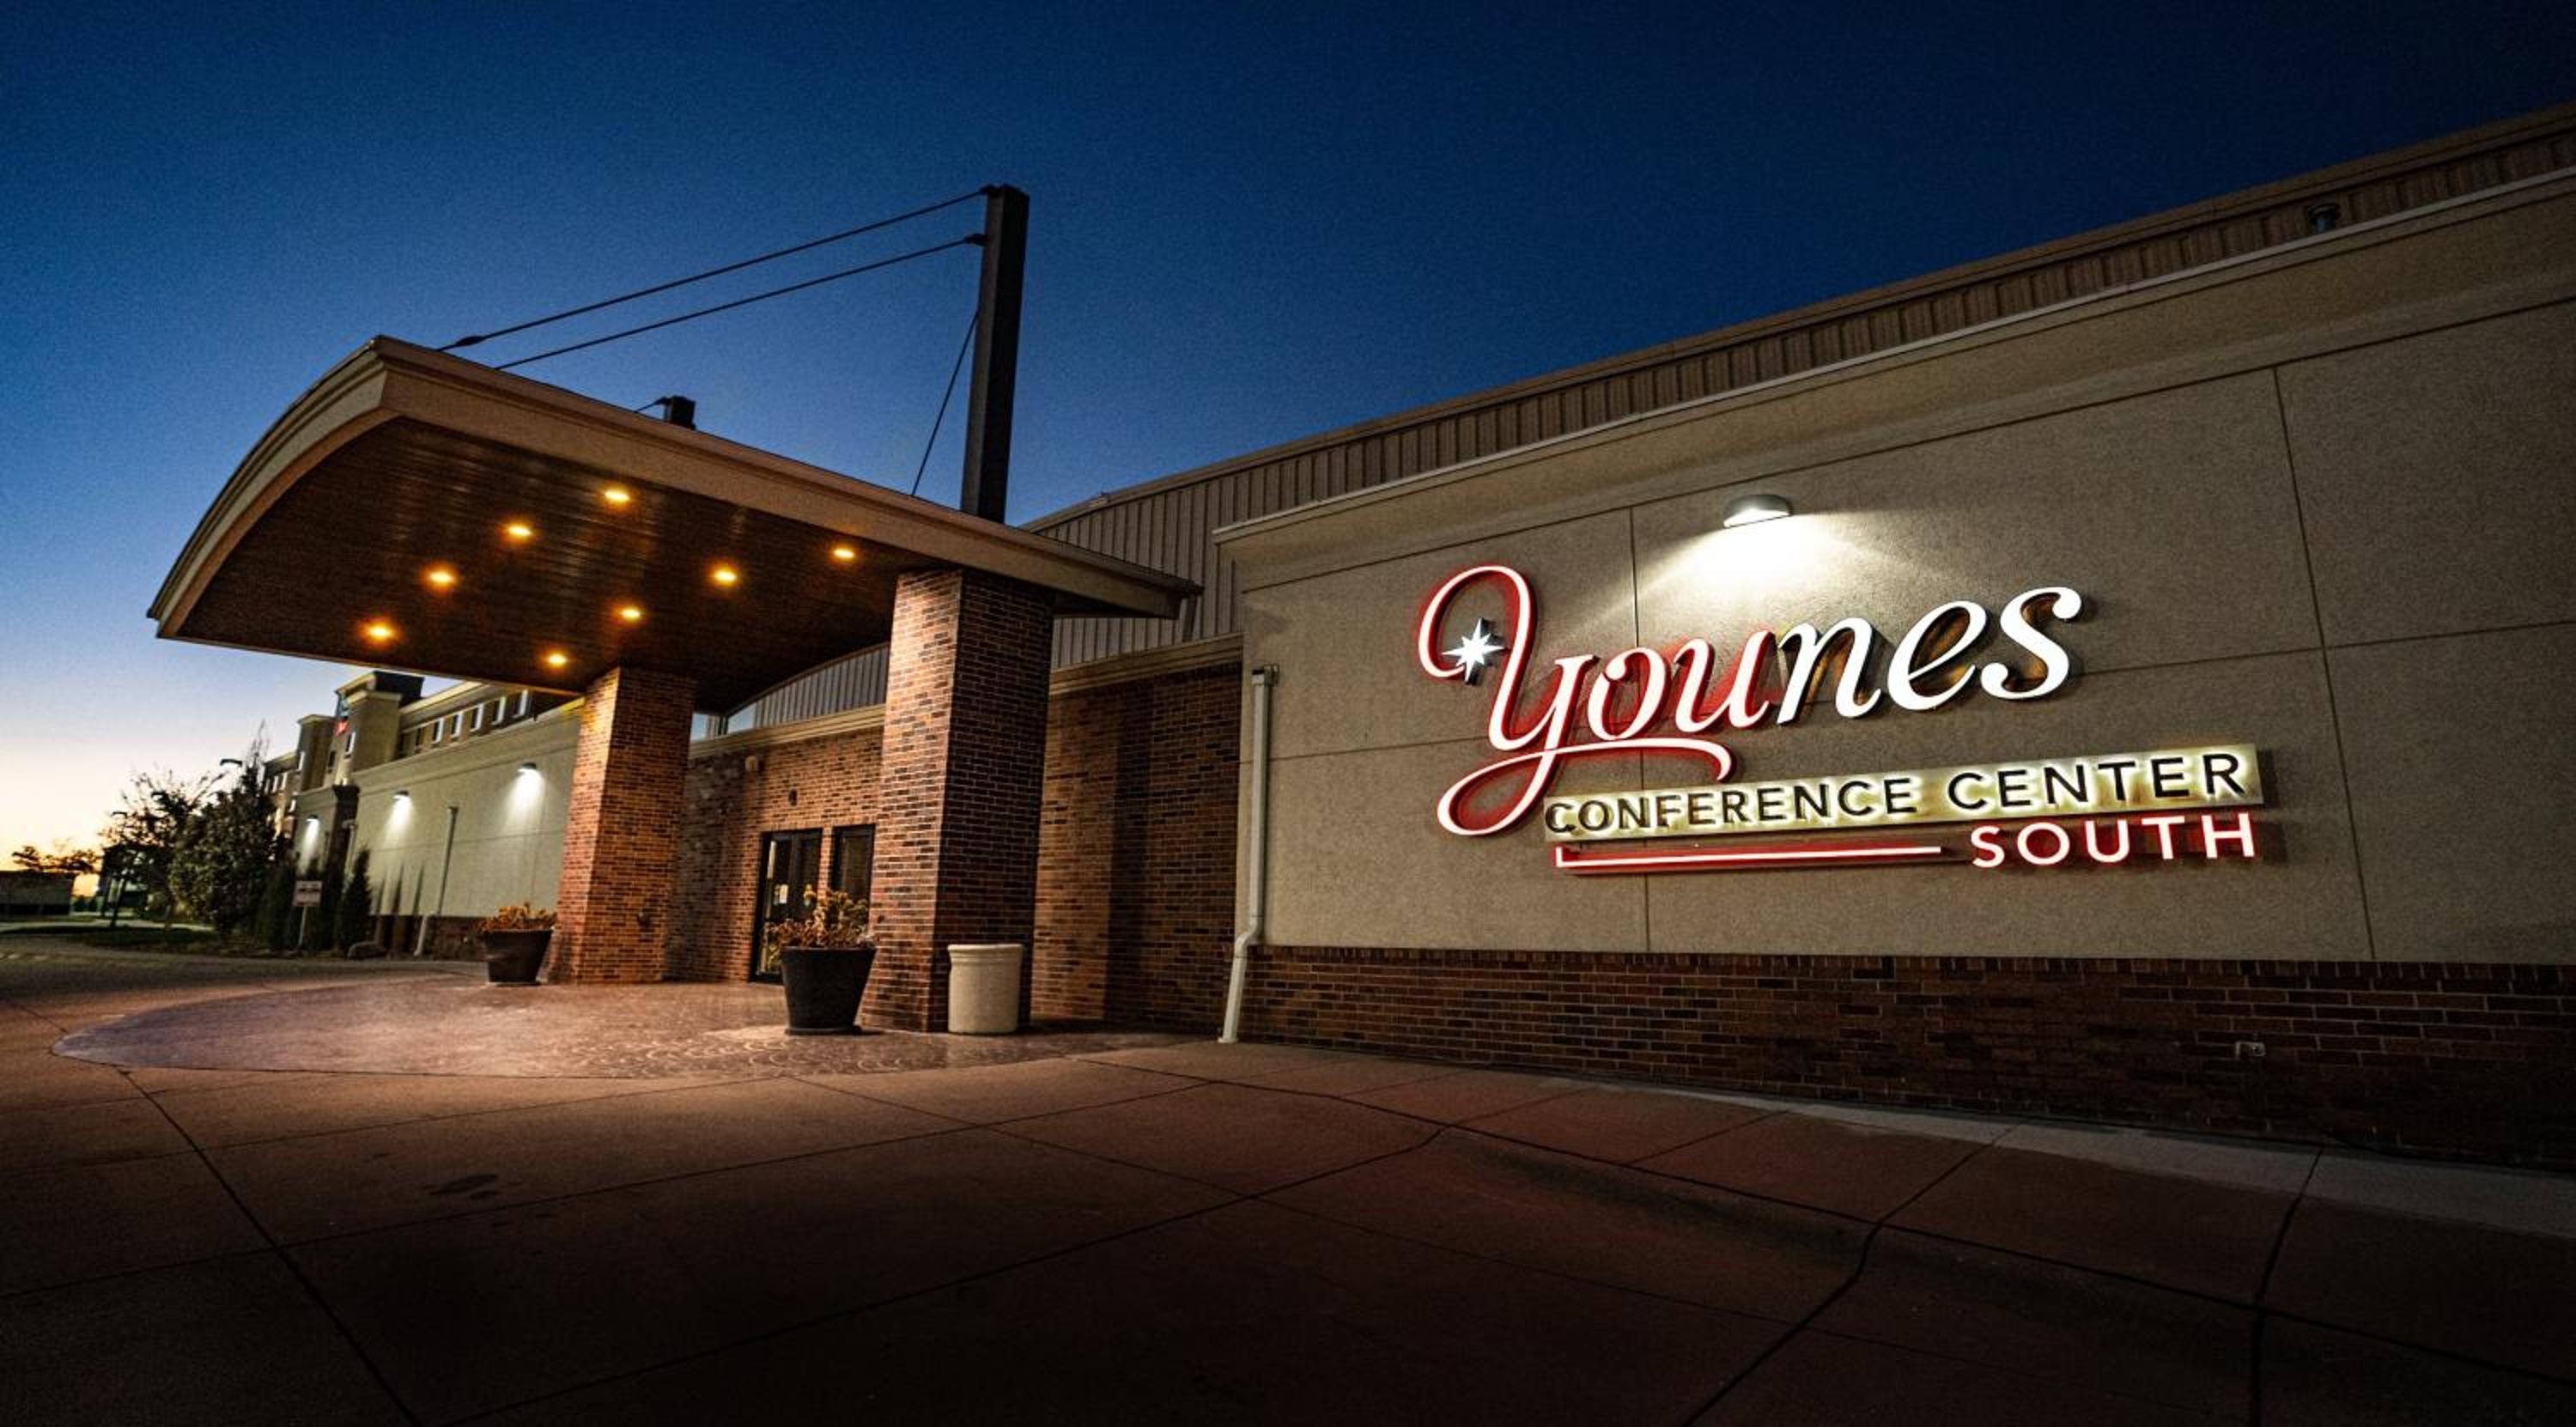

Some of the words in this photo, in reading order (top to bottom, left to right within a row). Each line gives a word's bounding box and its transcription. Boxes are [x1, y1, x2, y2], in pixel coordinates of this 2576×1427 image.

[1545, 776, 1917, 835] CONFERENCE
[1947, 752, 2245, 811] CENTER
[1970, 811, 2256, 869] SOUTH
